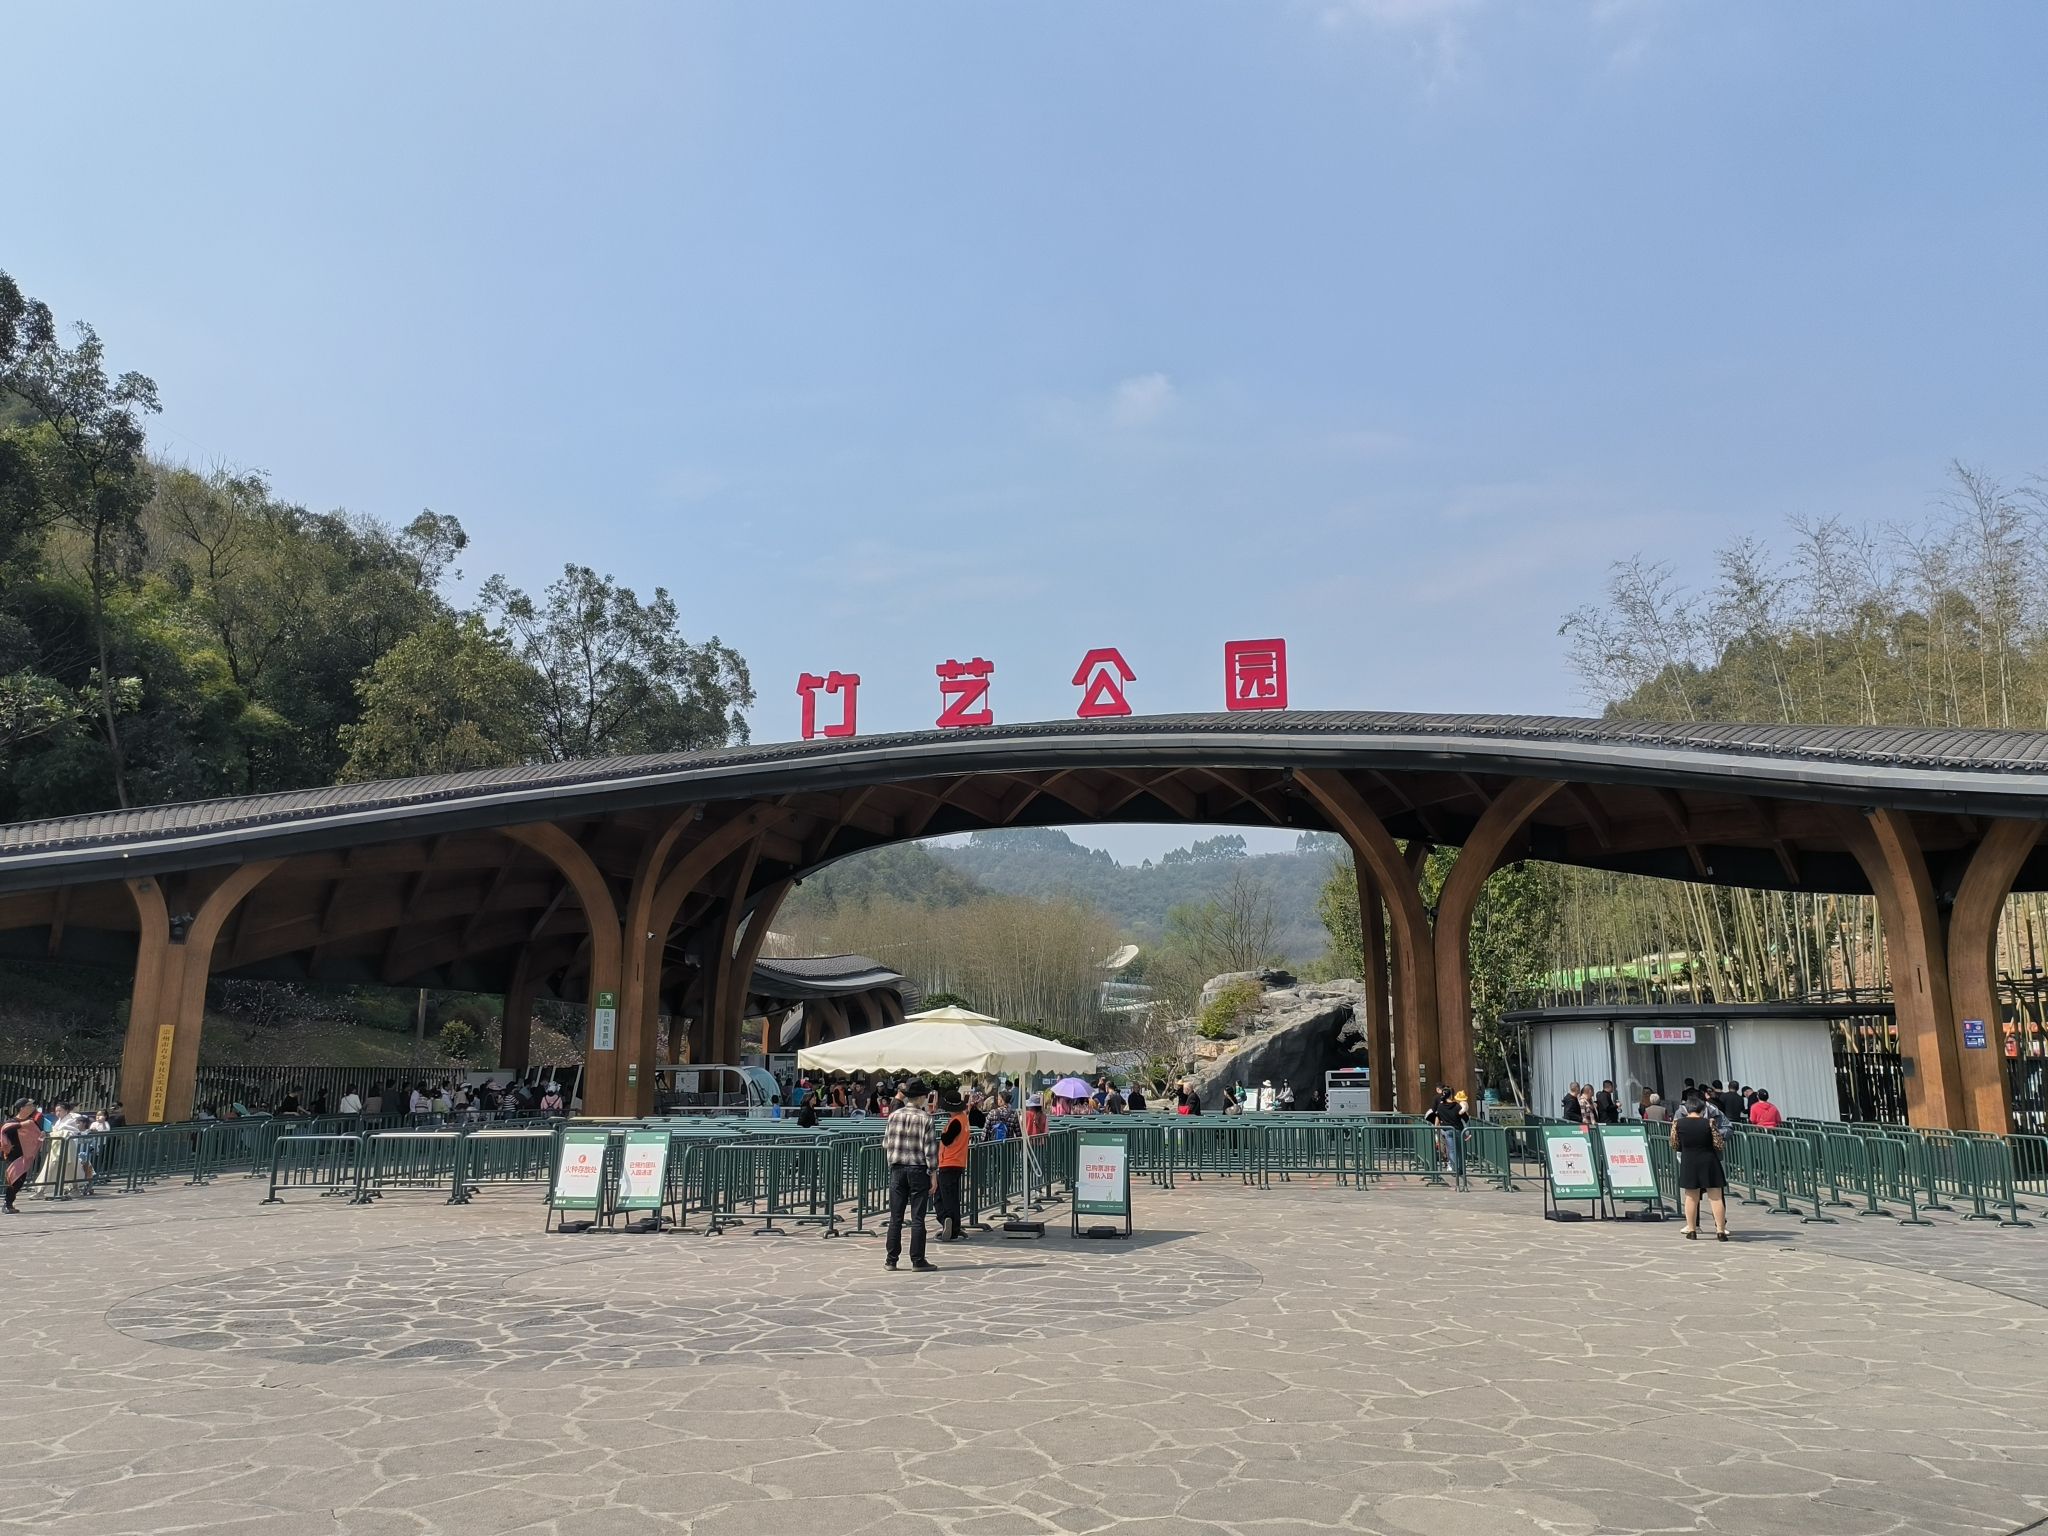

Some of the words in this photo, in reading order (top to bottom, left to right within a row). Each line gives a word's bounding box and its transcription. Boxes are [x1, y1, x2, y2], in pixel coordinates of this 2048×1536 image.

[796, 638, 1288, 740] 竹艺公园
[602, 1011, 610, 1047] 自动售票机
[1654, 1029, 1692, 1039] 售票窗口
[1610, 1155, 1644, 1164] 购票通道
[564, 1165, 598, 1174] 火种存放处
[629, 1161, 656, 1169] 已预约团队
[1085, 1164, 1117, 1172] 已购票游客
[1088, 1172, 1114, 1180] 排队入园
